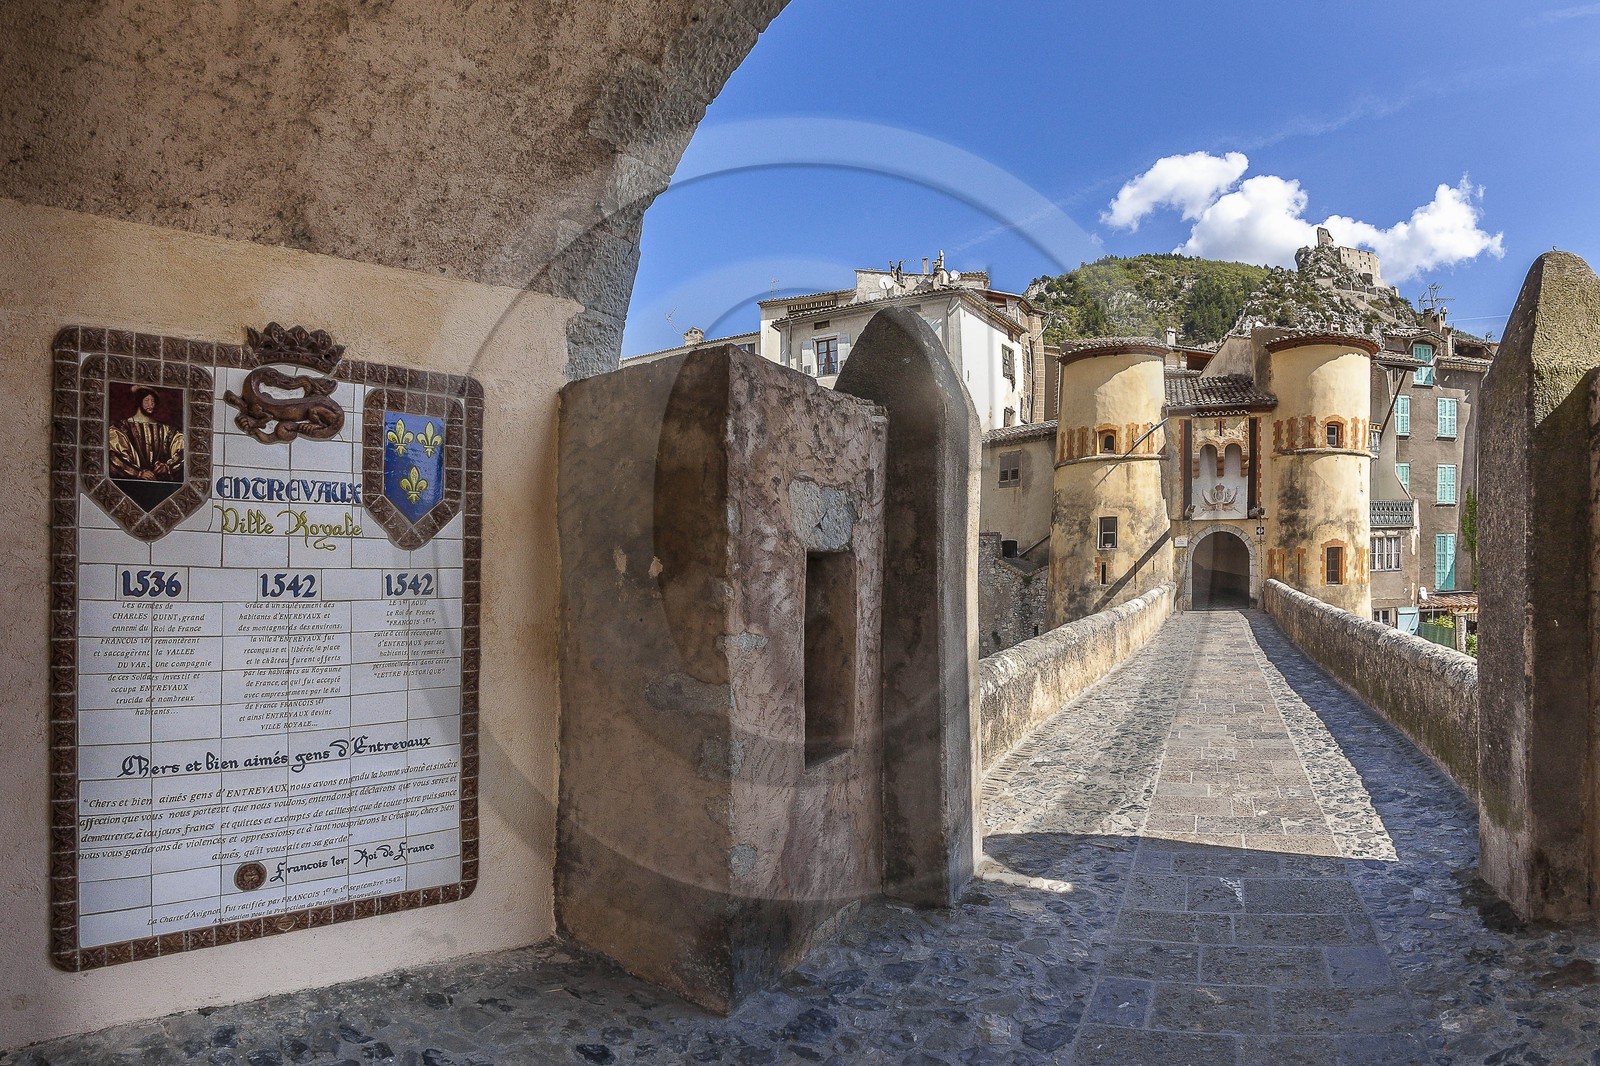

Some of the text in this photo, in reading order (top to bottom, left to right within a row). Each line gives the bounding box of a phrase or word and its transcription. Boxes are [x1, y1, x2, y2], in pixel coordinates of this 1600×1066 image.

[215, 474, 362, 505] ENTREVAUX
[214, 504, 362, 551] Ville Royale
[121, 569, 182, 598] 1536
[260, 573, 317, 598] 1542
[385, 572, 438, 596] 1542
[112, 612, 149, 620] CHARLES
[139, 683, 189, 692] ENTREVAUX
[117, 754, 180, 778] Chers
[185, 760, 202, 772] et
[205, 751, 239, 771] bien
[243, 750, 289, 767] aimés
[291, 749, 330, 773] gens
[130, 797, 153, 806] bien
[158, 792, 188, 804] aimés
[189, 791, 213, 803] gens
[288, 782, 311, 792] nous
[312, 778, 338, 788] avons
[79, 815, 121, 832] affection
[121, 815, 140, 825] que
[168, 809, 191, 819] nous
[232, 804, 249, 814] que
[250, 801, 272, 811] nous
[181, 822, 215, 837] francs
[102, 849, 124, 858] vous
[393, 841, 435, 861] France
